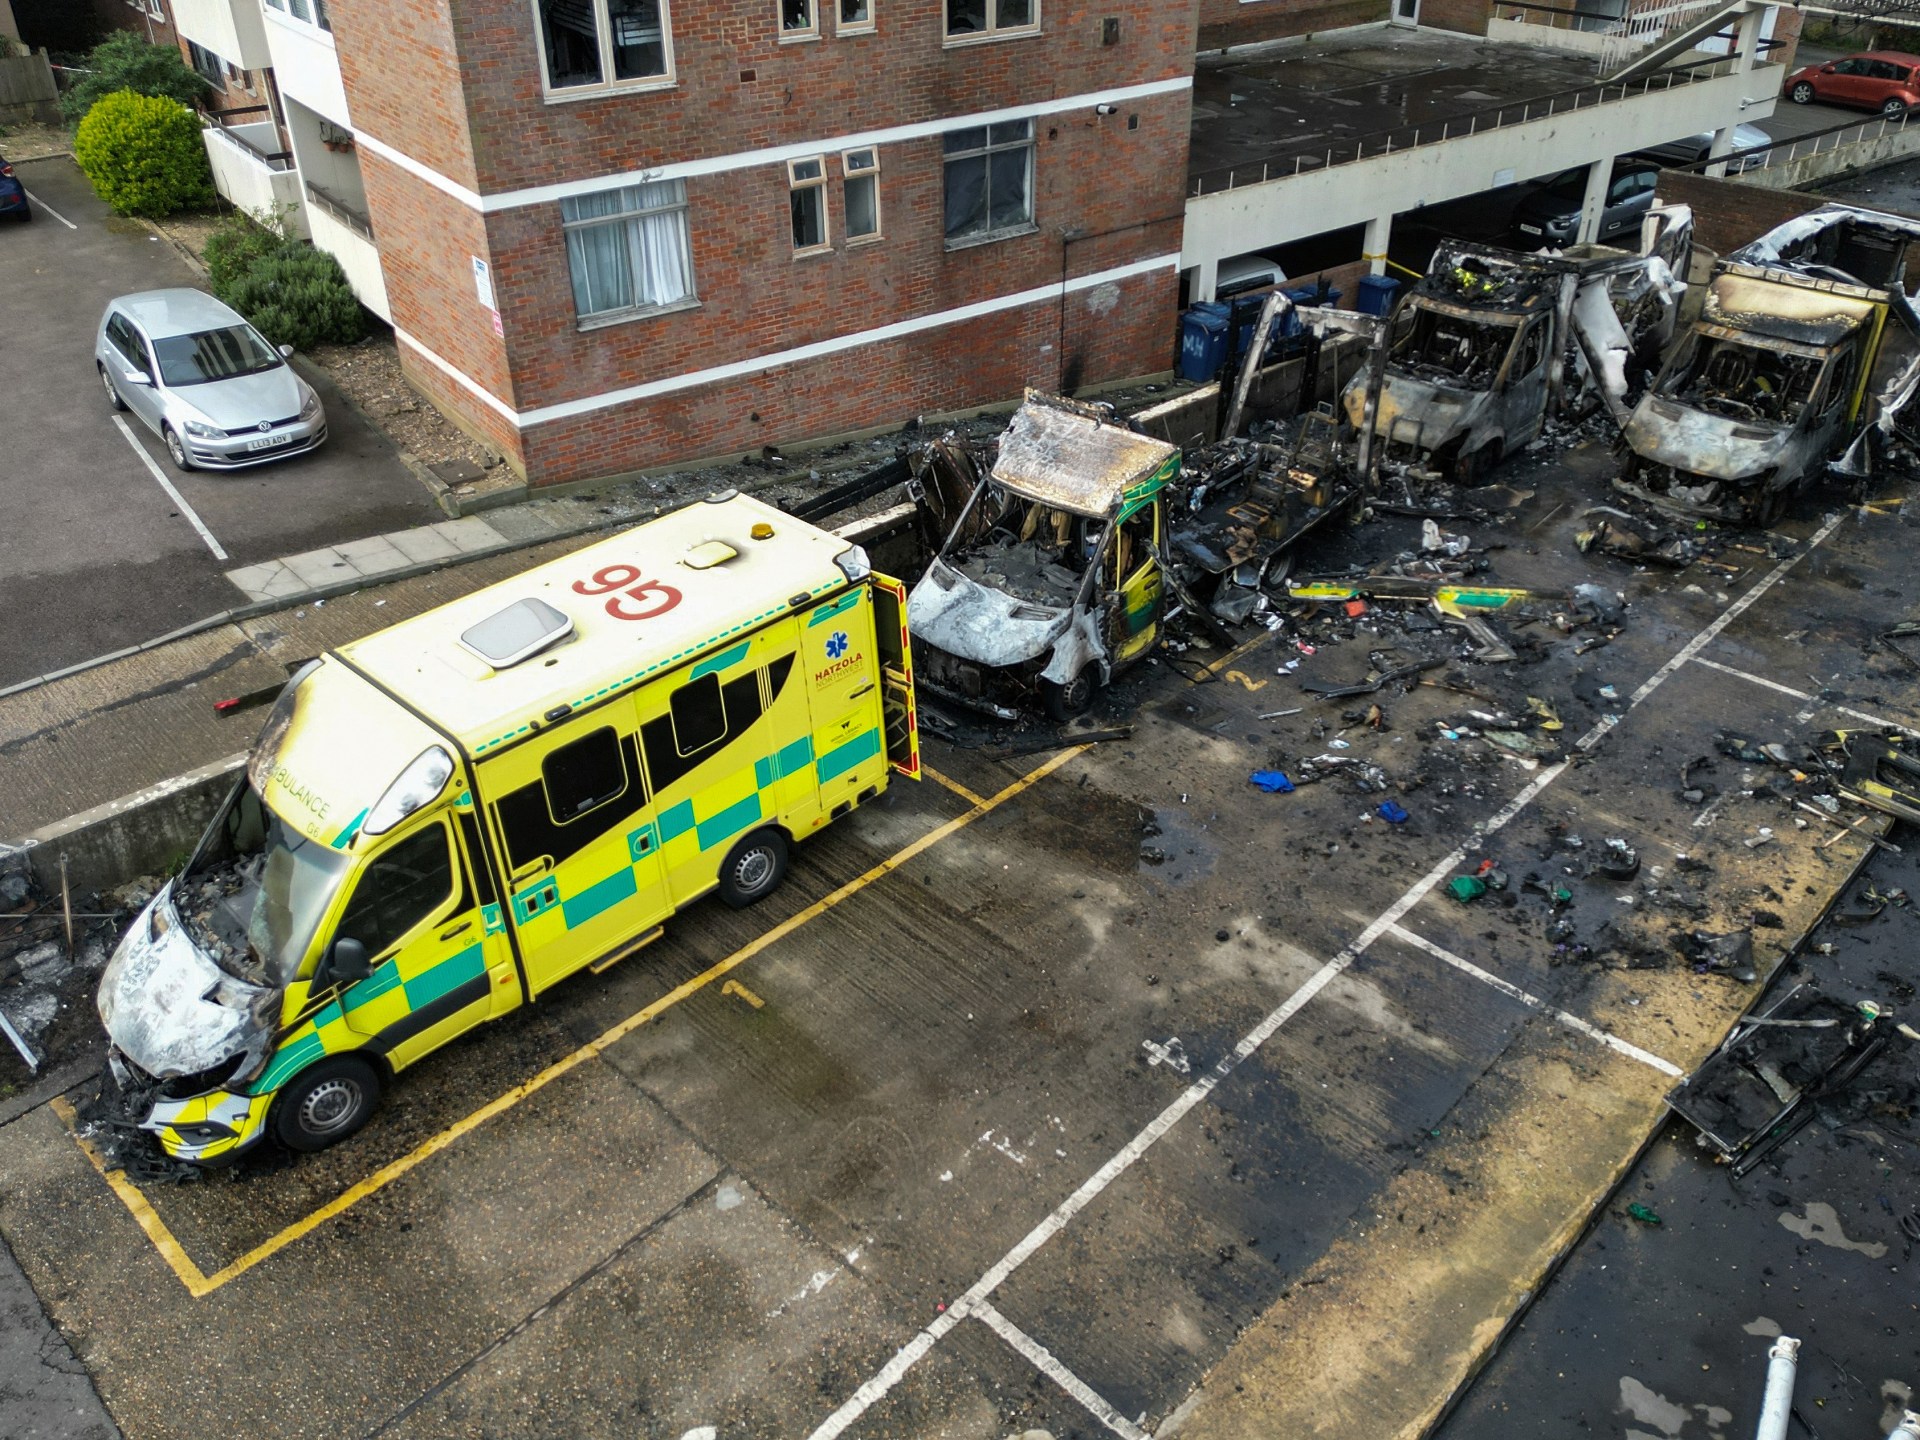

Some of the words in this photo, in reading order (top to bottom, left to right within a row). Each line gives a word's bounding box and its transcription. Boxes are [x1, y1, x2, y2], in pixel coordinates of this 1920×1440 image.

[571, 564, 683, 621] G6
[815, 652, 863, 681] HATZOLA
[816, 660, 863, 688] NORTHWEST
[1225, 669, 1269, 692] 2
[273, 767, 331, 821] BULANCE
[306, 821, 321, 838] G6
[721, 979, 766, 1009] 1
